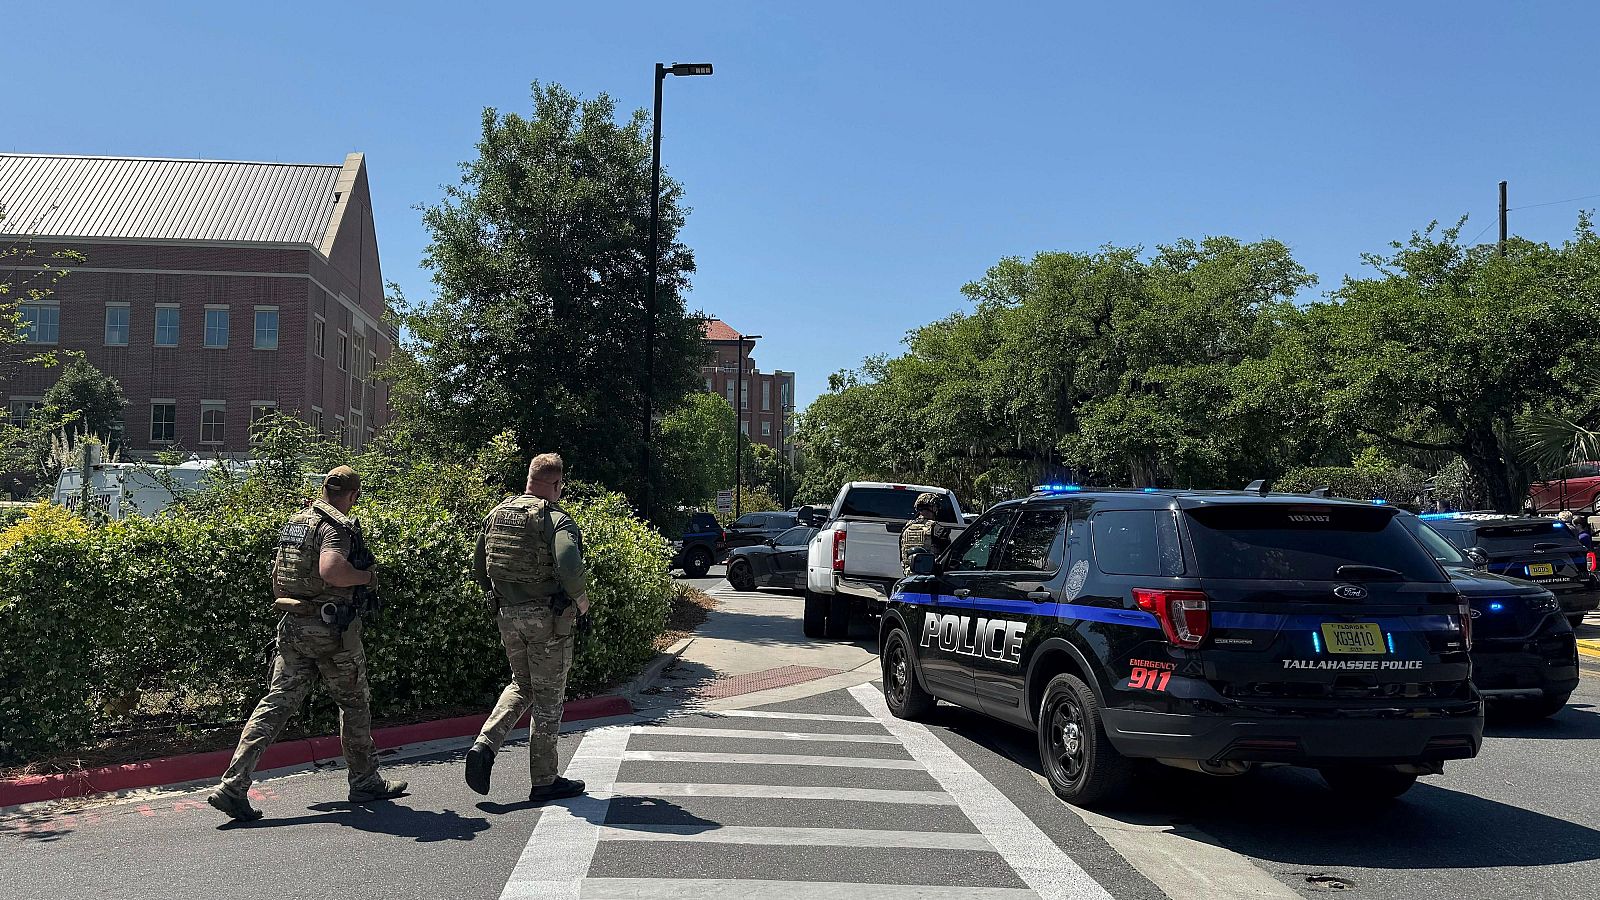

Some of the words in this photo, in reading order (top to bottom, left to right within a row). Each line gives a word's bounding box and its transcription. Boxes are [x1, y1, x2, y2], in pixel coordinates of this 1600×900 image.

[920, 611, 1027, 665] POLICE
[1333, 631, 1375, 647] XG9410
[1130, 658, 1178, 671] EMERGENCY
[1282, 659, 1379, 670] TALLAHASSEE
[1380, 660, 1423, 670] POLICE
[1128, 667, 1171, 692] 911
